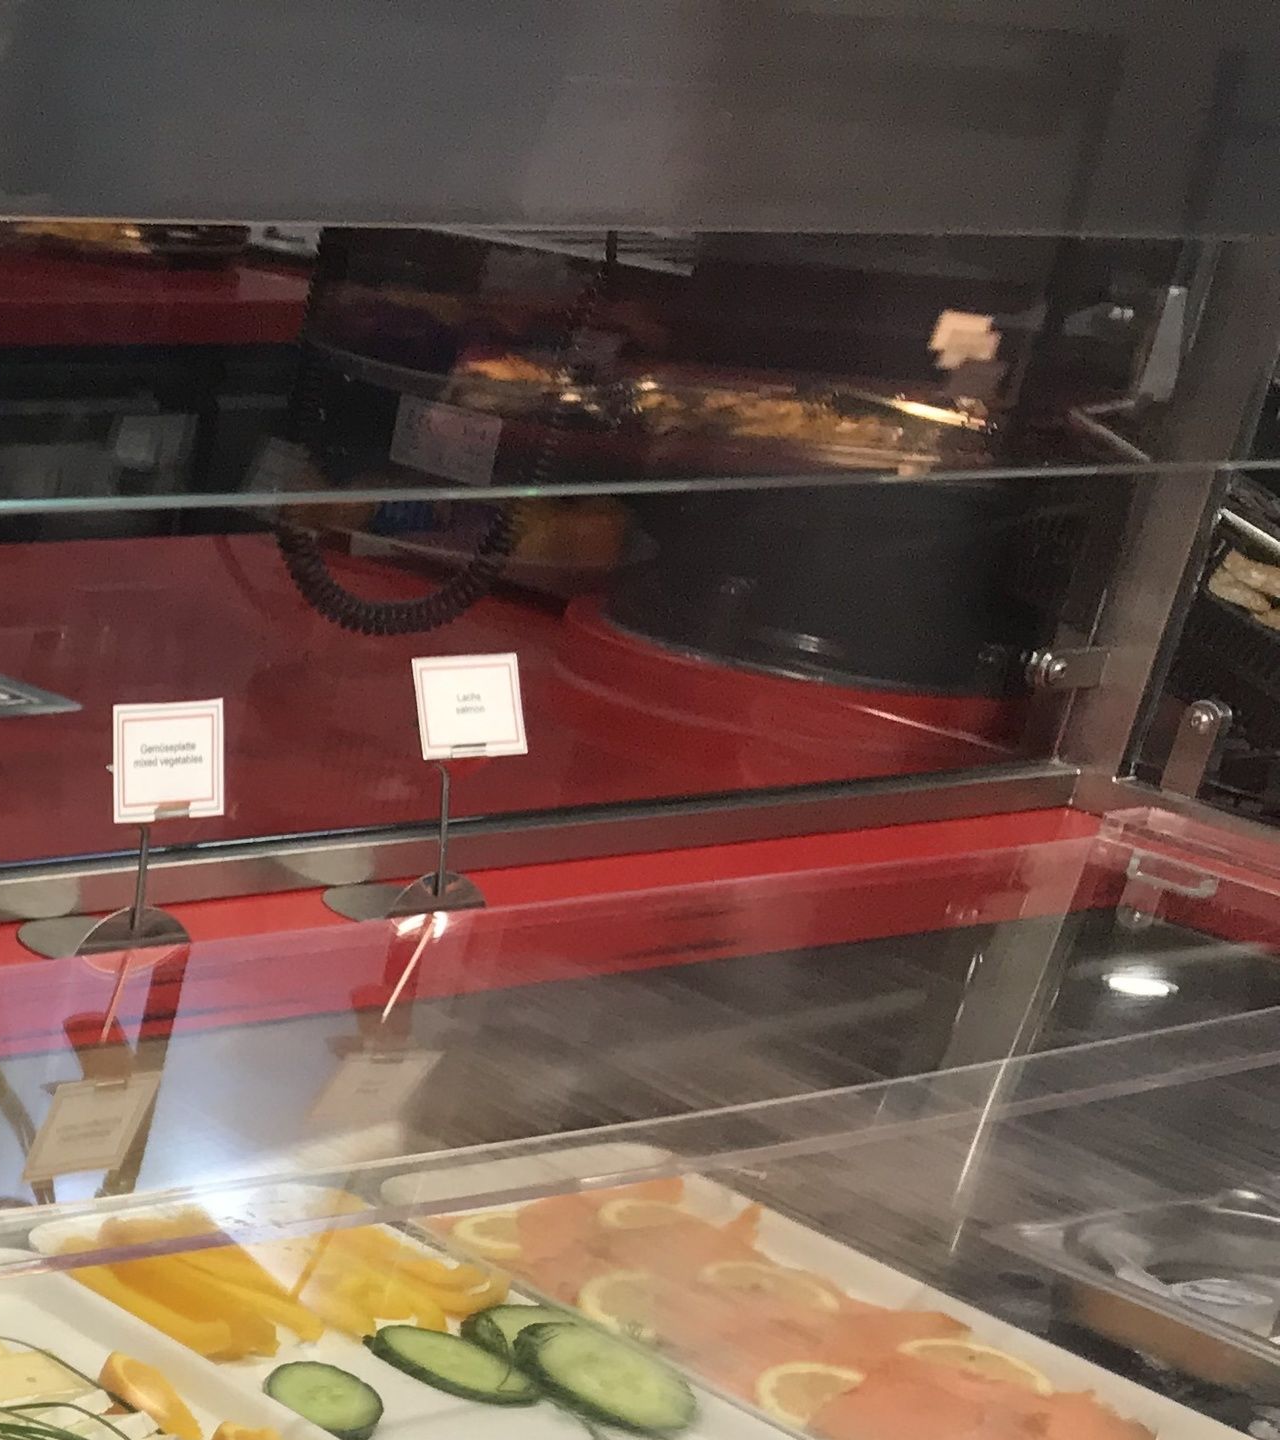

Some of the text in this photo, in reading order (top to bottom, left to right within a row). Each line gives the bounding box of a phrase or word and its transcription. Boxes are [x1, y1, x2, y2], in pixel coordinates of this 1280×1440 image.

[456, 705, 485, 714] salmon
[140, 741, 196, 754] Gemüseplatte
[133, 755, 203, 767] mixed vegetables
